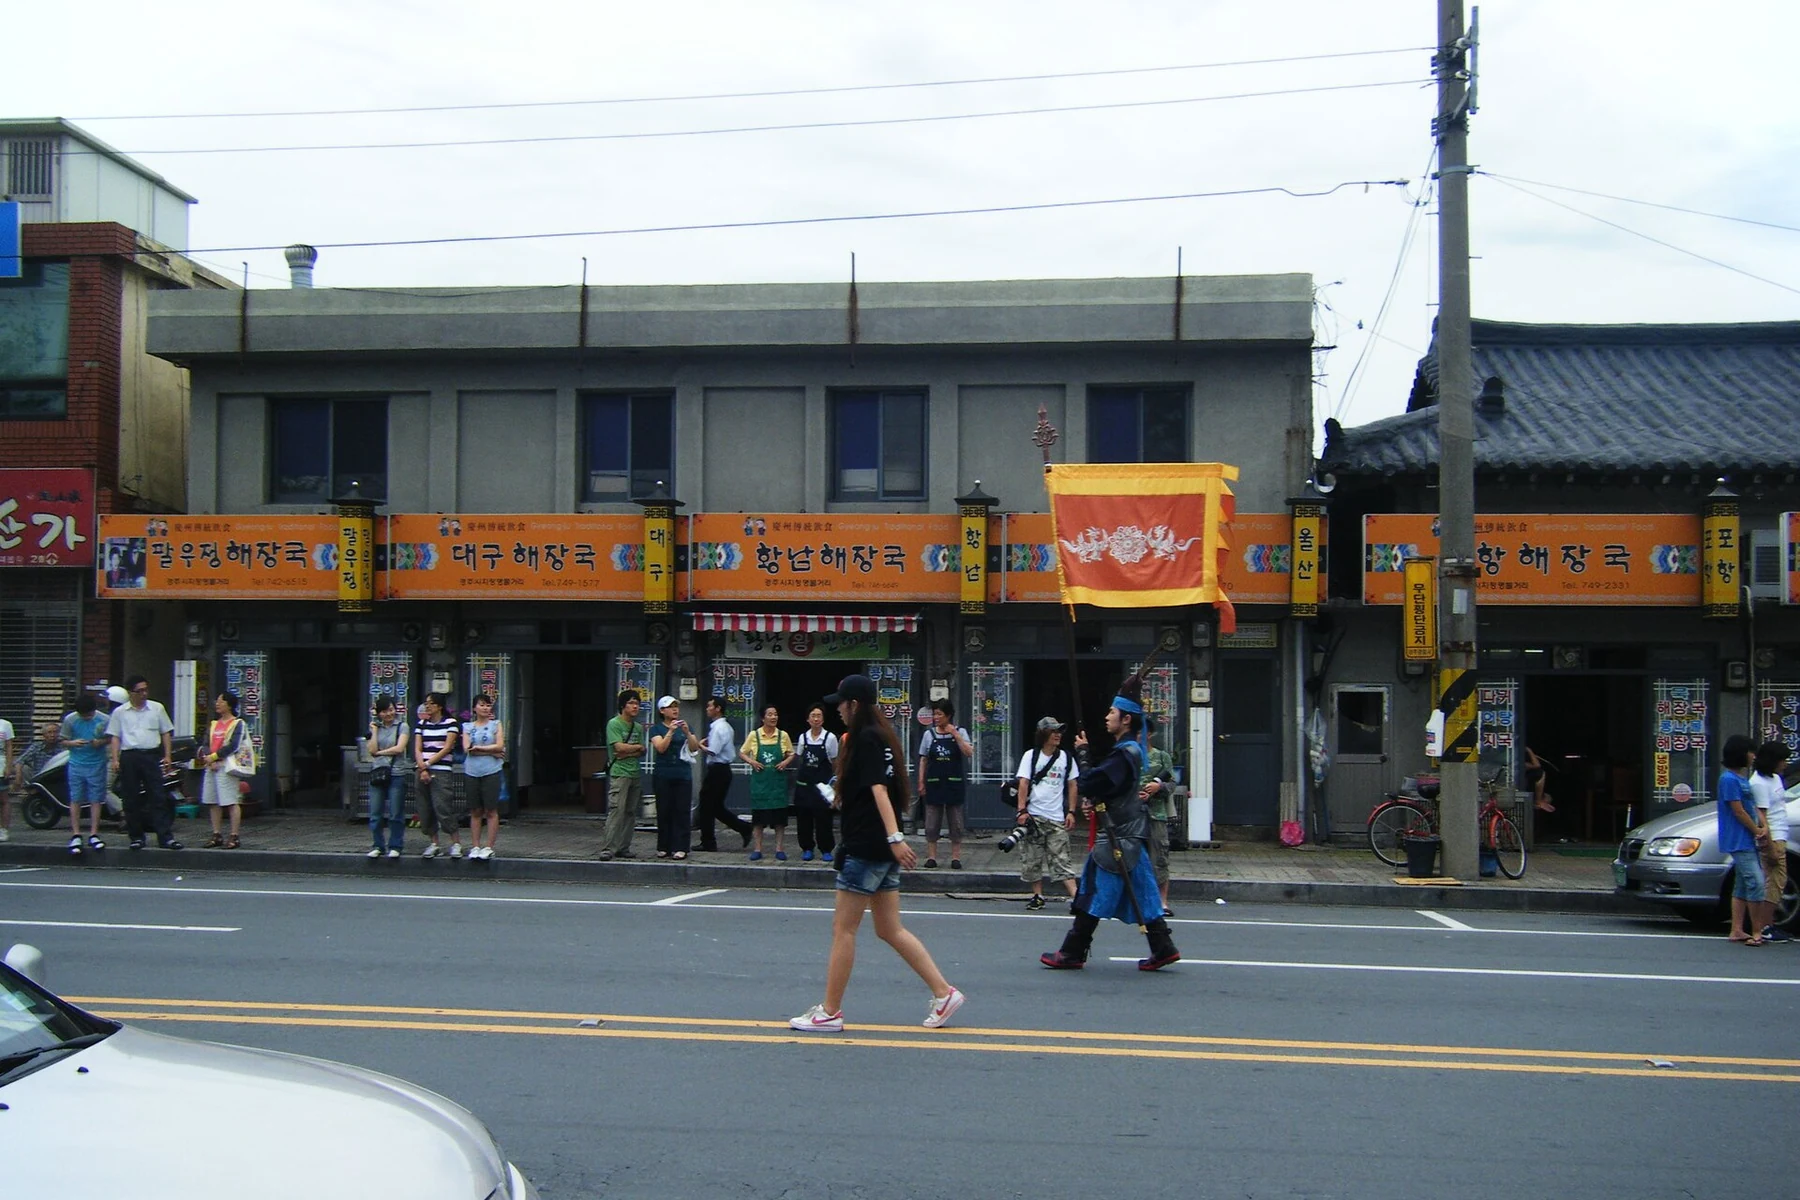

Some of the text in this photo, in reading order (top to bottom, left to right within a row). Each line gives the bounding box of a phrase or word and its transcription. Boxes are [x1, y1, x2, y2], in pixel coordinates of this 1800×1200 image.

[151, 540, 309, 570] 팔우정해장국
[343, 528, 358, 590] 팔우정
[452, 542, 597, 572] 대구해장국
[650, 528, 665, 582] 대구
[756, 542, 906, 574] 황남해장국
[965, 526, 982, 583] 황남
[1298, 527, 1314, 580] 울산
[1476, 541, 1631, 576] 항해장국
[1718, 528, 1736, 584] 포항
[1413, 583, 1427, 646] 무단횡단금지
[712, 683, 756, 700] 추어탕
[883, 703, 913, 719] 장국
[1481, 711, 1514, 727] 어탕
[1656, 701, 1708, 717] 해장국
[1483, 732, 1514, 749] 지국
[1656, 735, 1708, 752] 해장국
